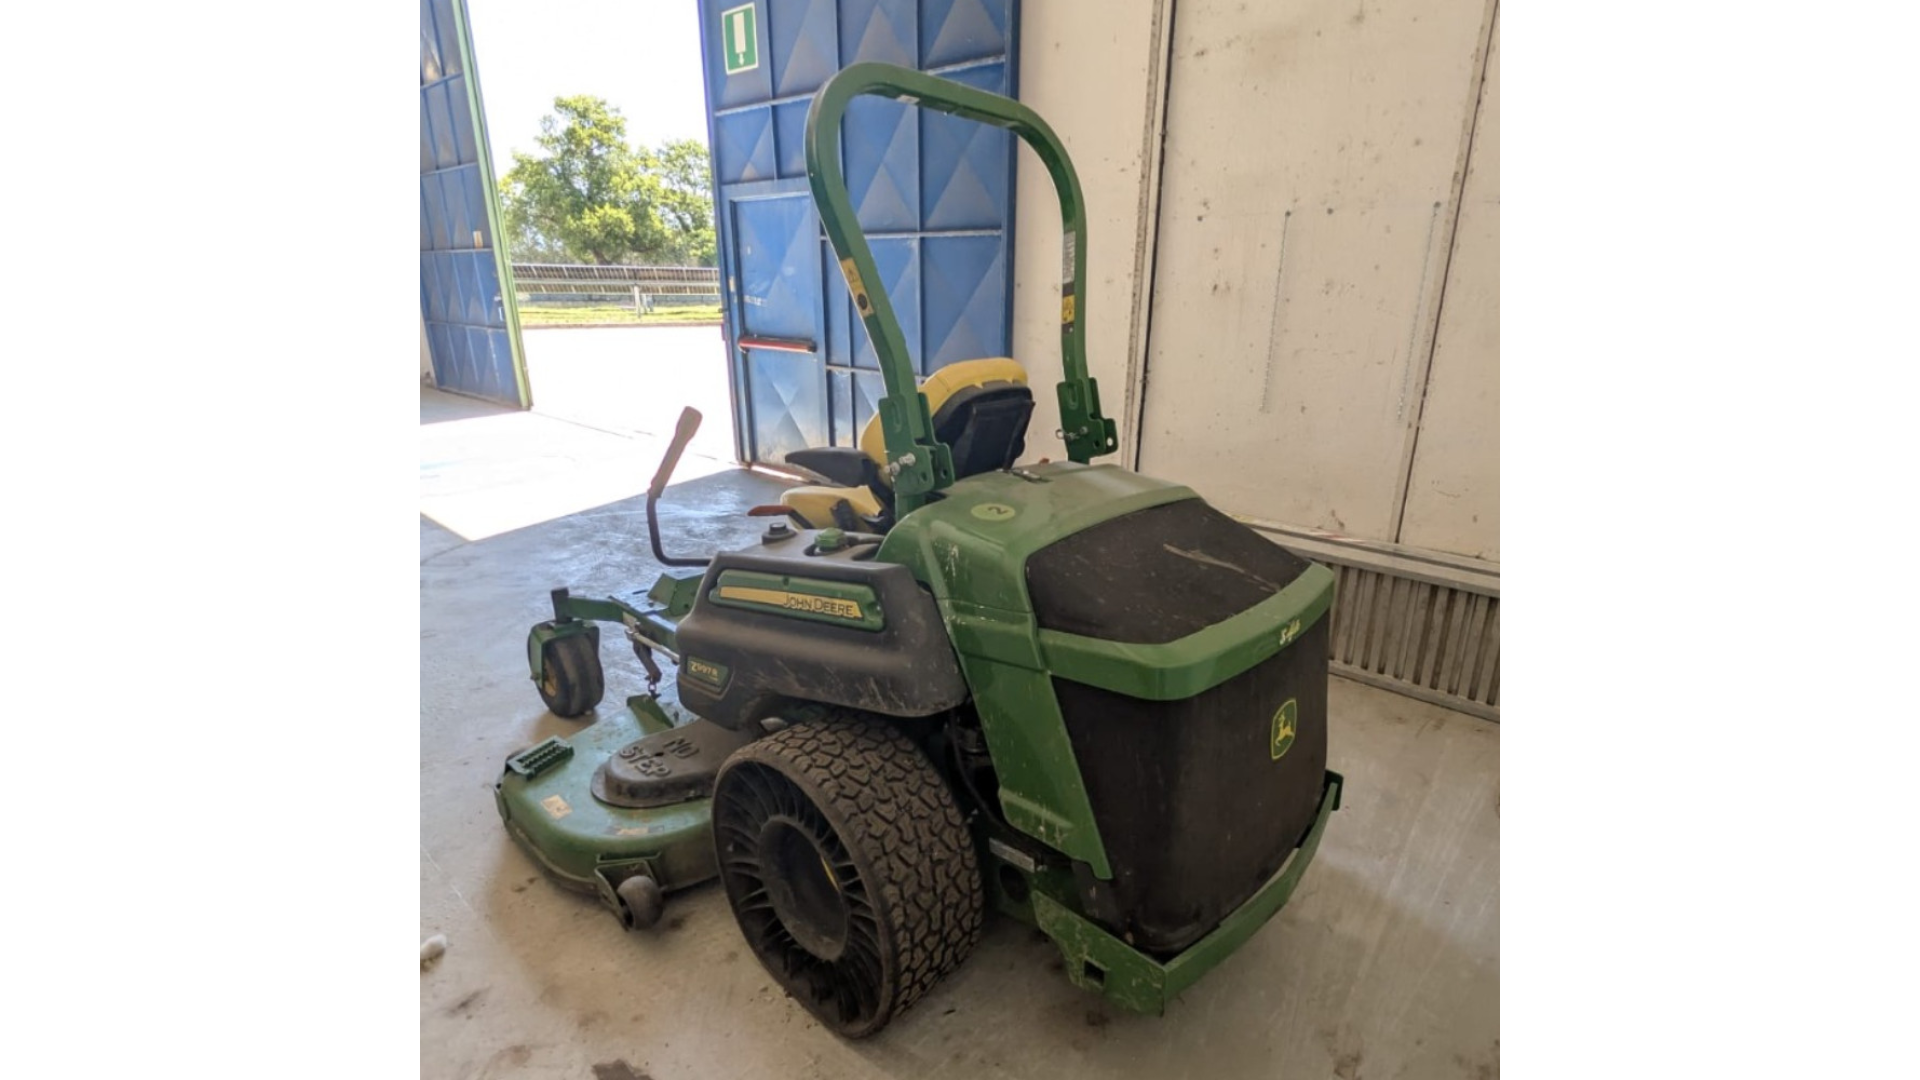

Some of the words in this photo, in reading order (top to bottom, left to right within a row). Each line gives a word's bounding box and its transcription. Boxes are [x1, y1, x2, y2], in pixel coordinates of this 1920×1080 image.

[783, 594, 812, 611] JOHN
[814, 598, 854, 616] DEERE
[662, 737, 700, 759] NO
[618, 745, 672, 777] STEP
